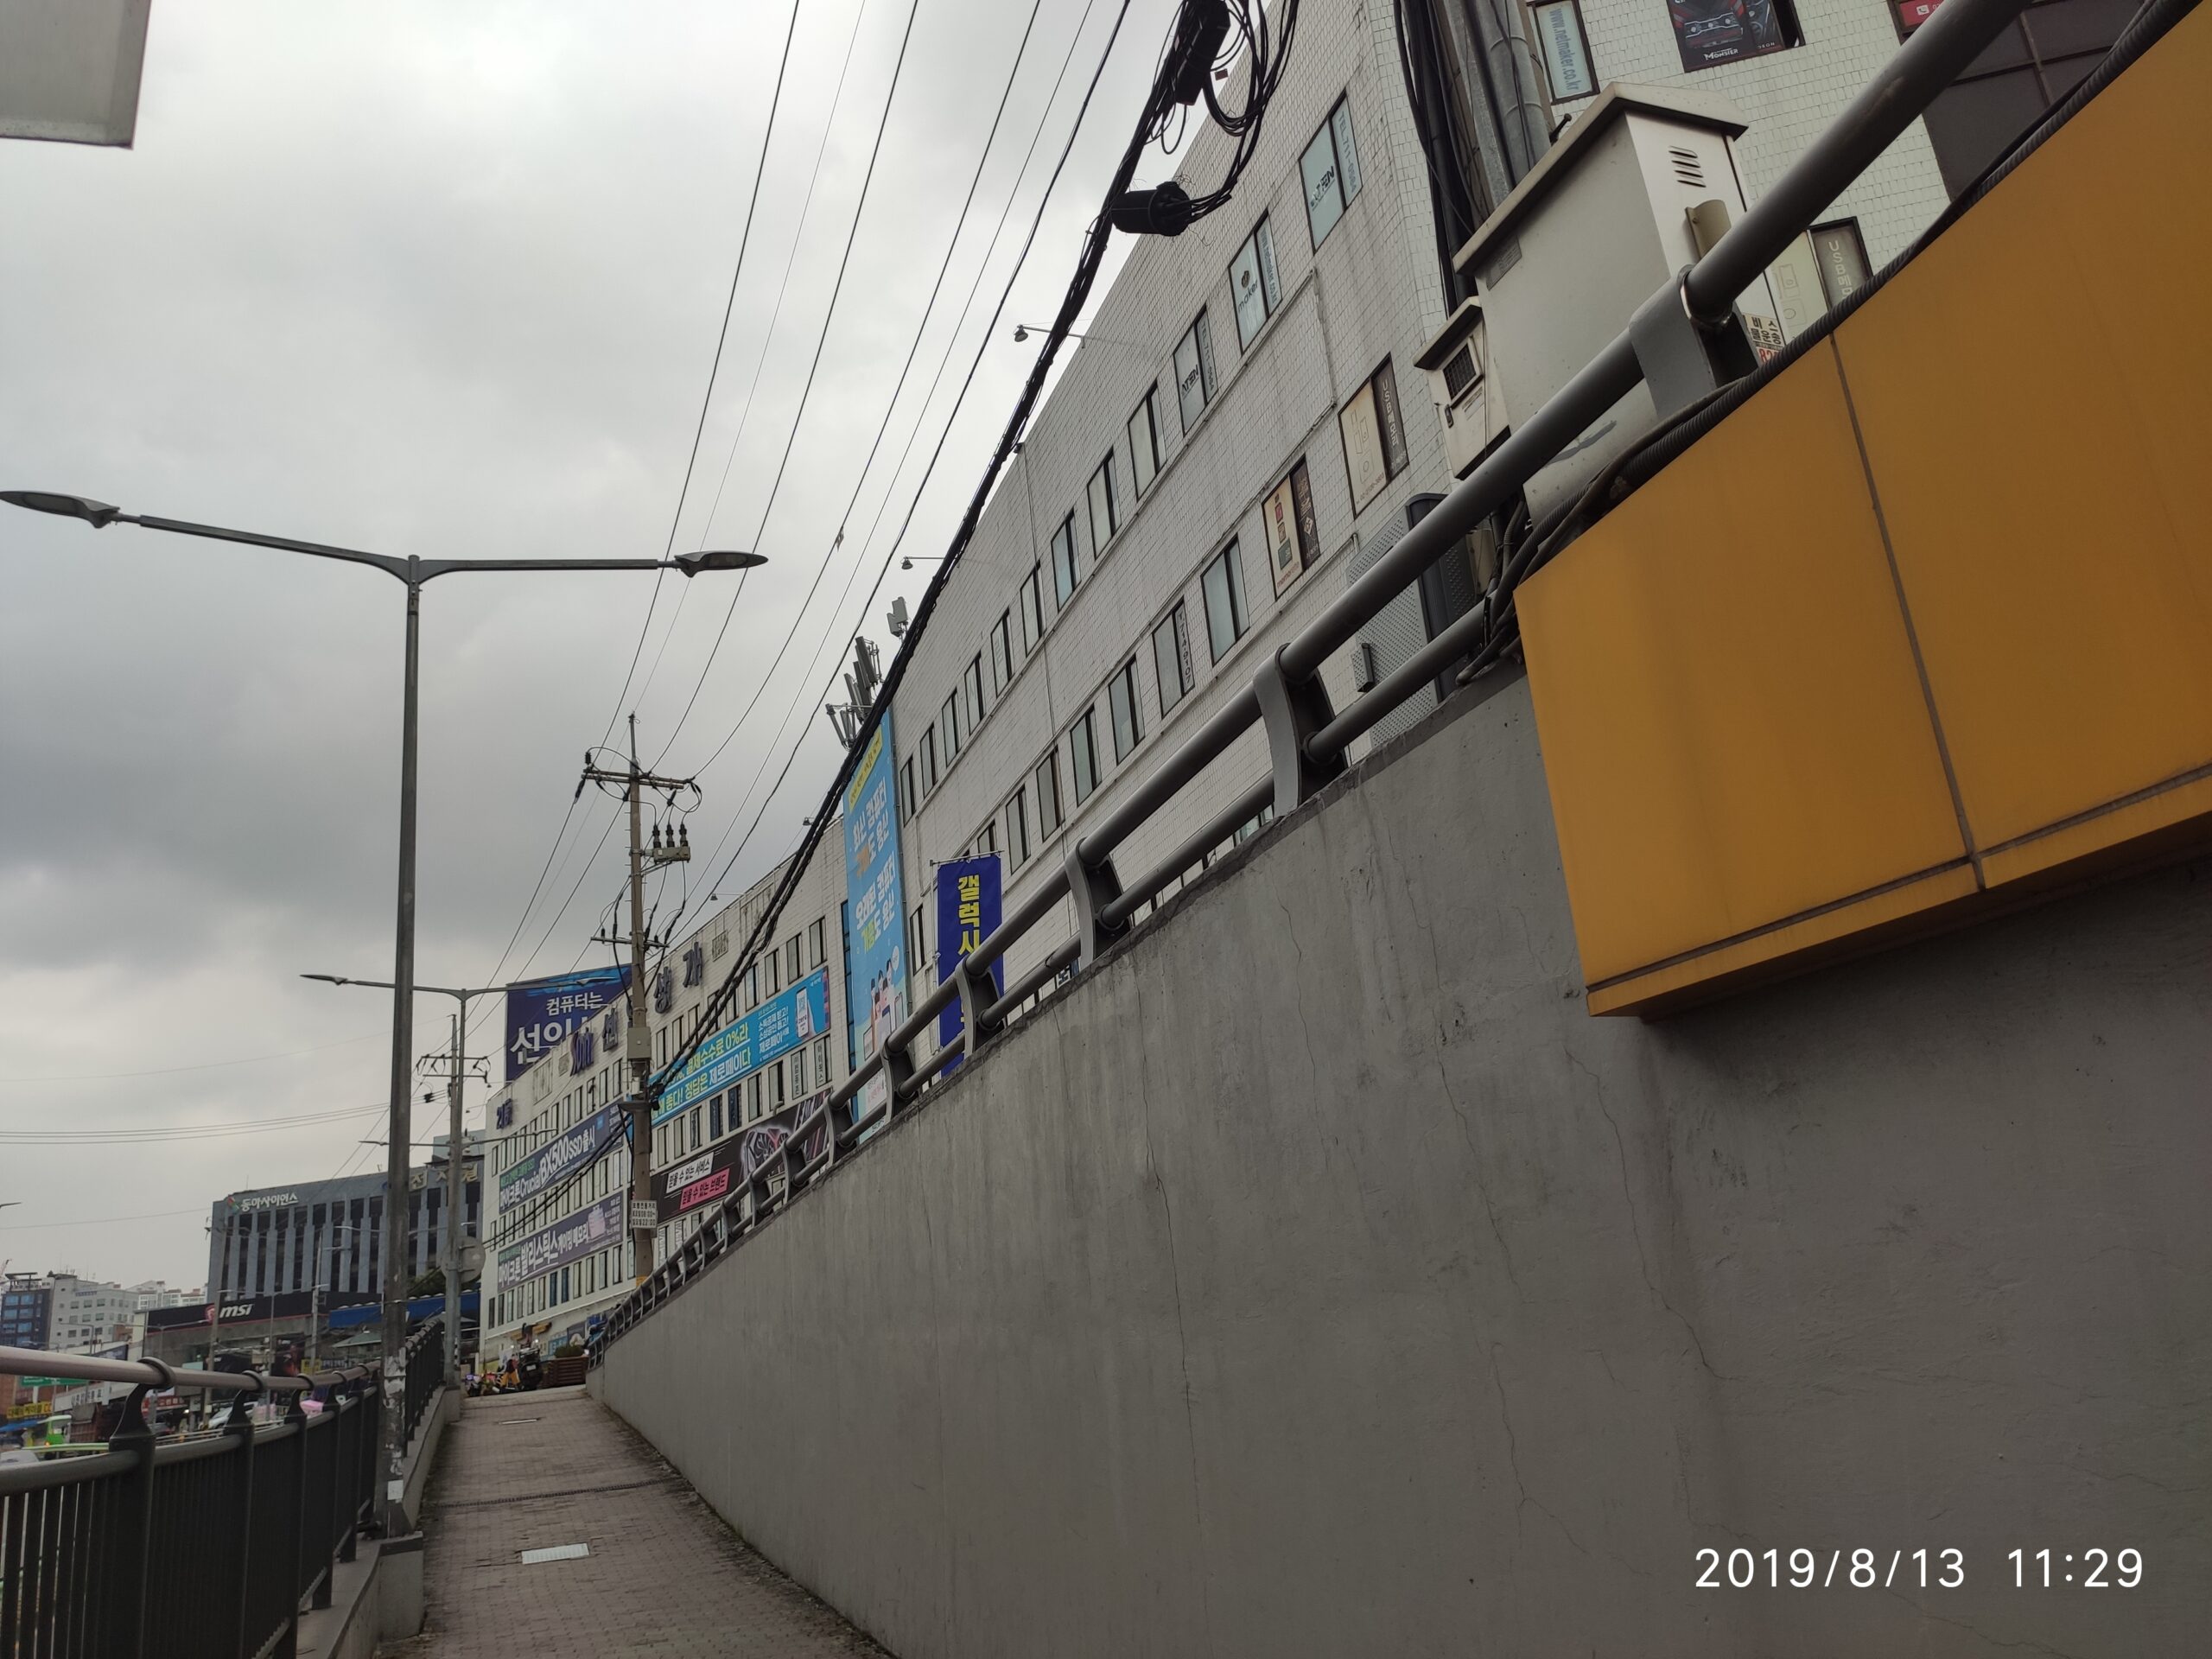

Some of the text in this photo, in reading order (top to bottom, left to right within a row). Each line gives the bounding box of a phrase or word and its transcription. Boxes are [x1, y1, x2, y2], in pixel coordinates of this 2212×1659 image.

[1549, 8, 1582, 91] www.netmaker.co.kr
[1703, 48, 1738, 61] MONSTER
[957, 874, 982, 956] 갤럭시
[546, 991, 604, 1017] 컴퓨터는
[685, 1072, 708, 1101] 정답은
[709, 1046, 752, 1086] 제로페이다
[519, 1171, 541, 1199] Crucial
[539, 1134, 570, 1185] BX500
[569, 1134, 583, 1160] SSD
[582, 1124, 595, 1153] 출시
[669, 1172, 679, 1189] 믿을
[684, 1165, 695, 1181] 있는
[695, 1158, 709, 1176] 서비스
[240, 1192, 299, 1212] 동아사이언스
[682, 1188, 692, 1205] 믿을
[698, 1181, 709, 1198] 있는
[709, 1173, 727, 1192] 브랜드
[520, 1230, 559, 1277] 발리스틱스
[572, 1222, 589, 1247] 메모리
[219, 1303, 254, 1319] msi
